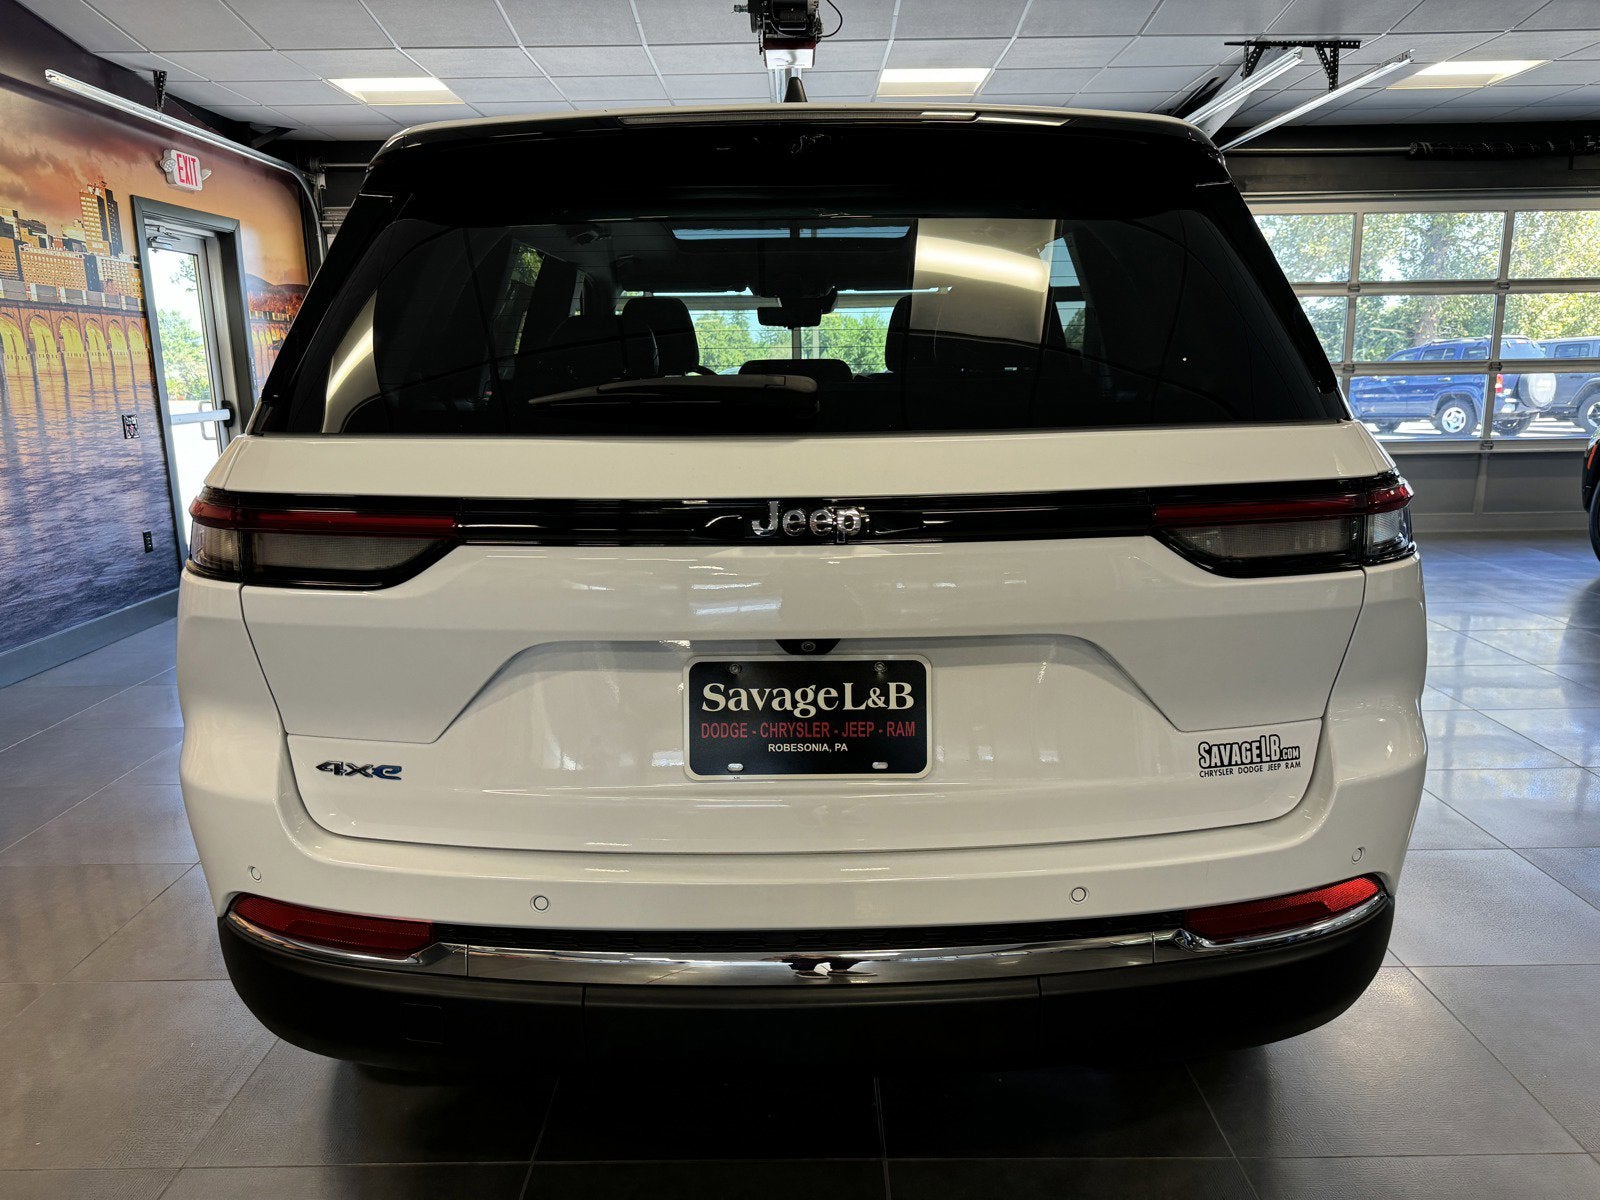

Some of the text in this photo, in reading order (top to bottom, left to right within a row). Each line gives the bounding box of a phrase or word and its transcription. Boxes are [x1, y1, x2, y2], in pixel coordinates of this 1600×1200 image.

[176, 153, 198, 187] EXIT
[751, 501, 862, 543] Jeep
[701, 722, 748, 739] DODGE
[760, 721, 830, 738] CHRYSLER
[842, 721, 875, 737] JEEP
[886, 721, 916, 737] RAM
[768, 742, 849, 753] ROBESONIA, PA
[1199, 761, 1301, 778] CHRYSLER DODGE JEEP RAM
